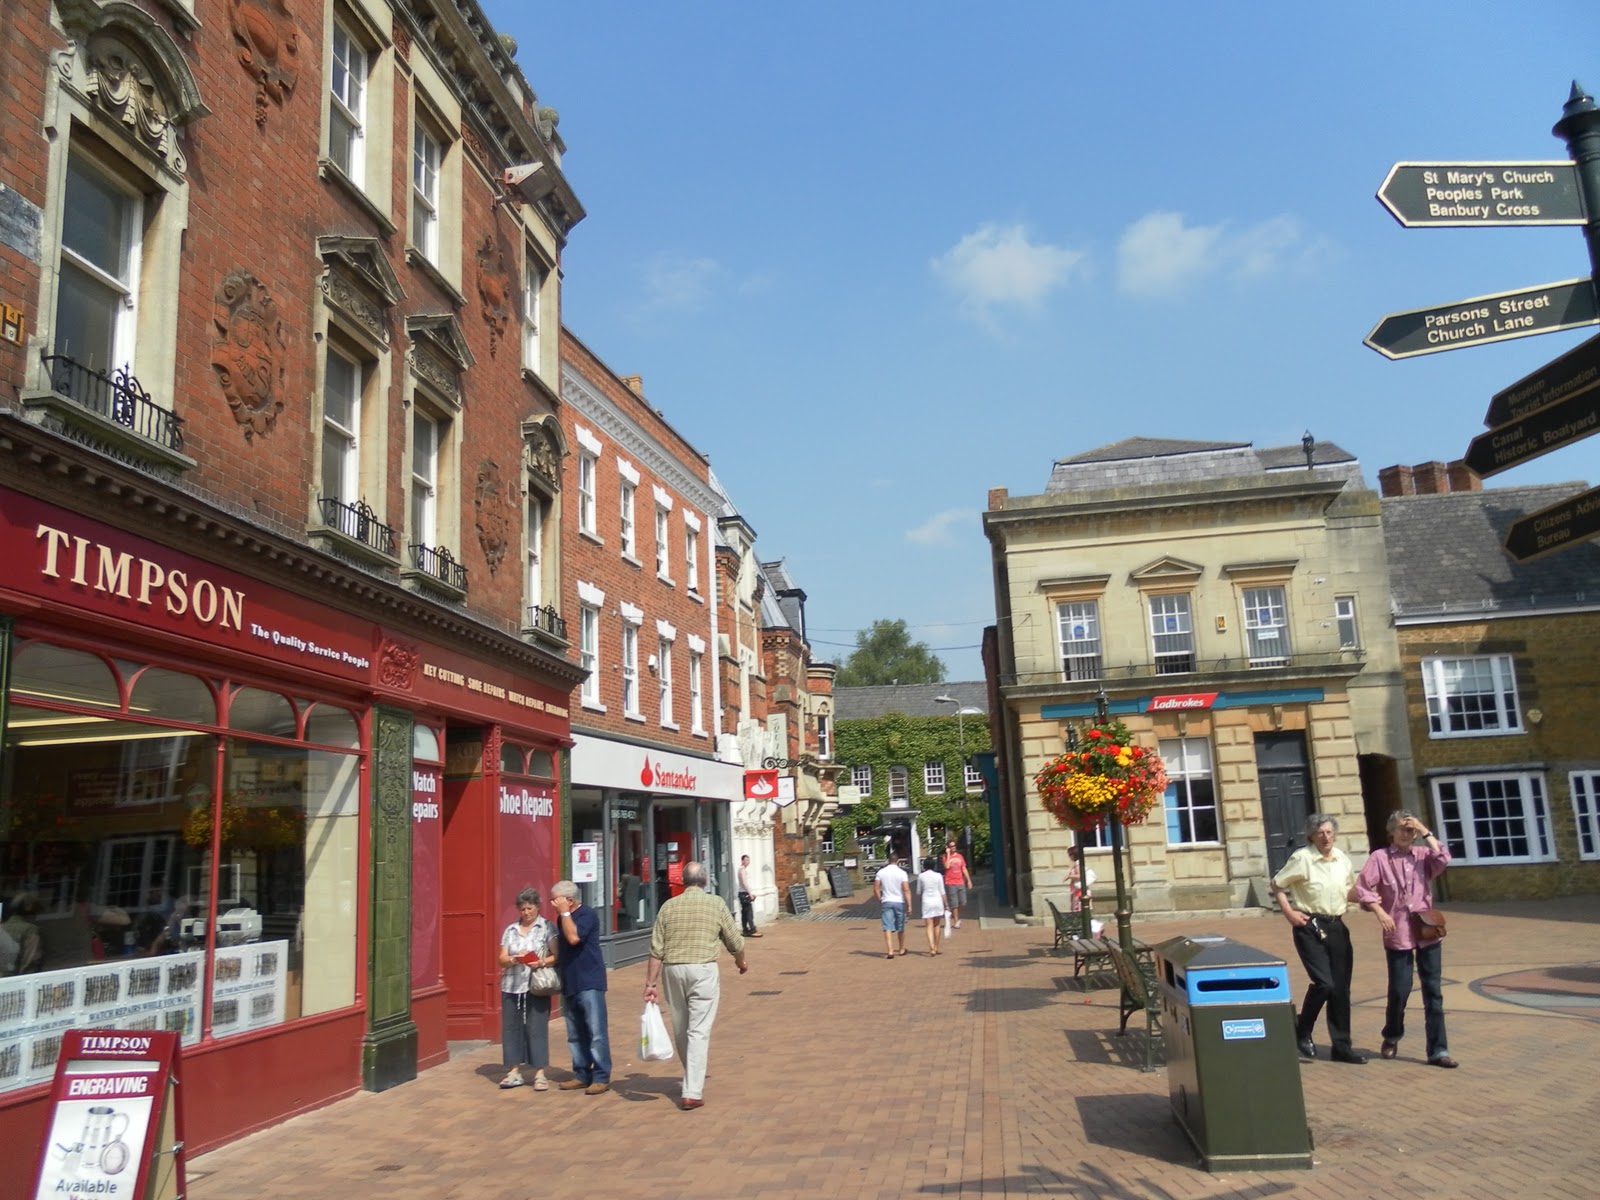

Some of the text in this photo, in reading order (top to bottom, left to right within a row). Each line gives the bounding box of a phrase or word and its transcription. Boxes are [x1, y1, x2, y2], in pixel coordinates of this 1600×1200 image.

[1423, 171, 1554, 186] St Mary's Church
[1426, 187, 1524, 202] Peoples Park
[1429, 203, 1540, 218] Banbury Cross
[1425, 294, 1550, 328] Parsons Street
[1427, 315, 1534, 343] Church Lane
[1508, 379, 1546, 404] Museum
[1511, 366, 1598, 419] Tourist Information
[1491, 426, 1524, 449] Canal
[1494, 411, 1597, 464] Historic Boatyard
[1534, 510, 1572, 532] Citizens
[1537, 527, 1571, 548] Bureau
[36, 524, 246, 631] TIMPSON
[251, 623, 370, 668] The Quality Service People
[423, 663, 438, 678] KEY
[438, 668, 465, 687] CUTTING
[467, 677, 483, 692] SHOE
[483, 682, 506, 700] REPAIRS
[508, 690, 525, 706] WATCH
[525, 696, 544, 711] REPAIRS
[1153, 698, 1204, 710] Ladbrokes
[655, 762, 697, 791] Santander
[413, 798, 439, 823] epairs
[522, 789, 553, 823] Repairs
[82, 1037, 151, 1049] TIMPSON
[69, 1076, 148, 1096] ENGRAVING
[56, 1179, 117, 1194] Available
